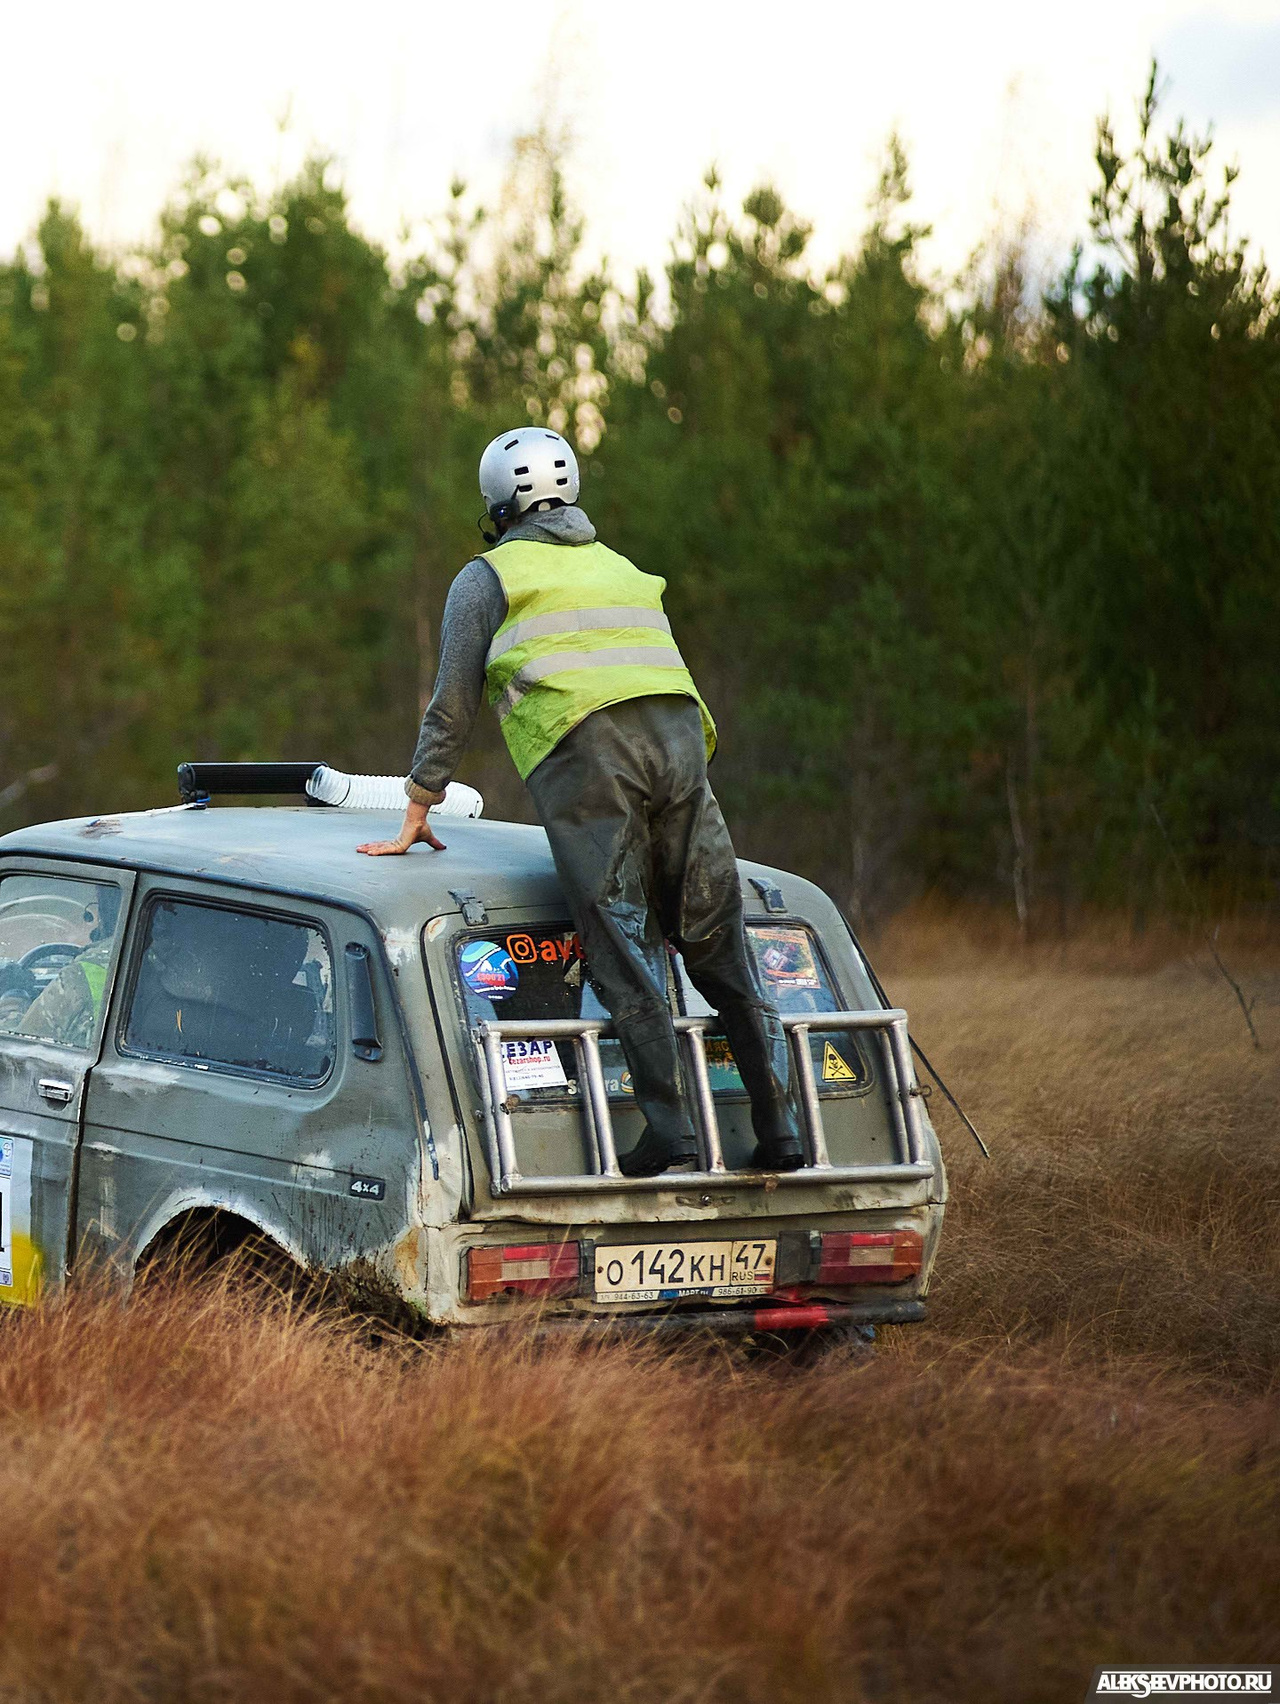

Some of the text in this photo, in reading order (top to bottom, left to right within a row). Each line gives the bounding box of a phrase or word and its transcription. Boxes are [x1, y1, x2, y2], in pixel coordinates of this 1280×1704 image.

[501, 1039, 553, 1059] ЕЗАР
[735, 1243, 767, 1270] 47
[732, 1270, 754, 1281] RUS
